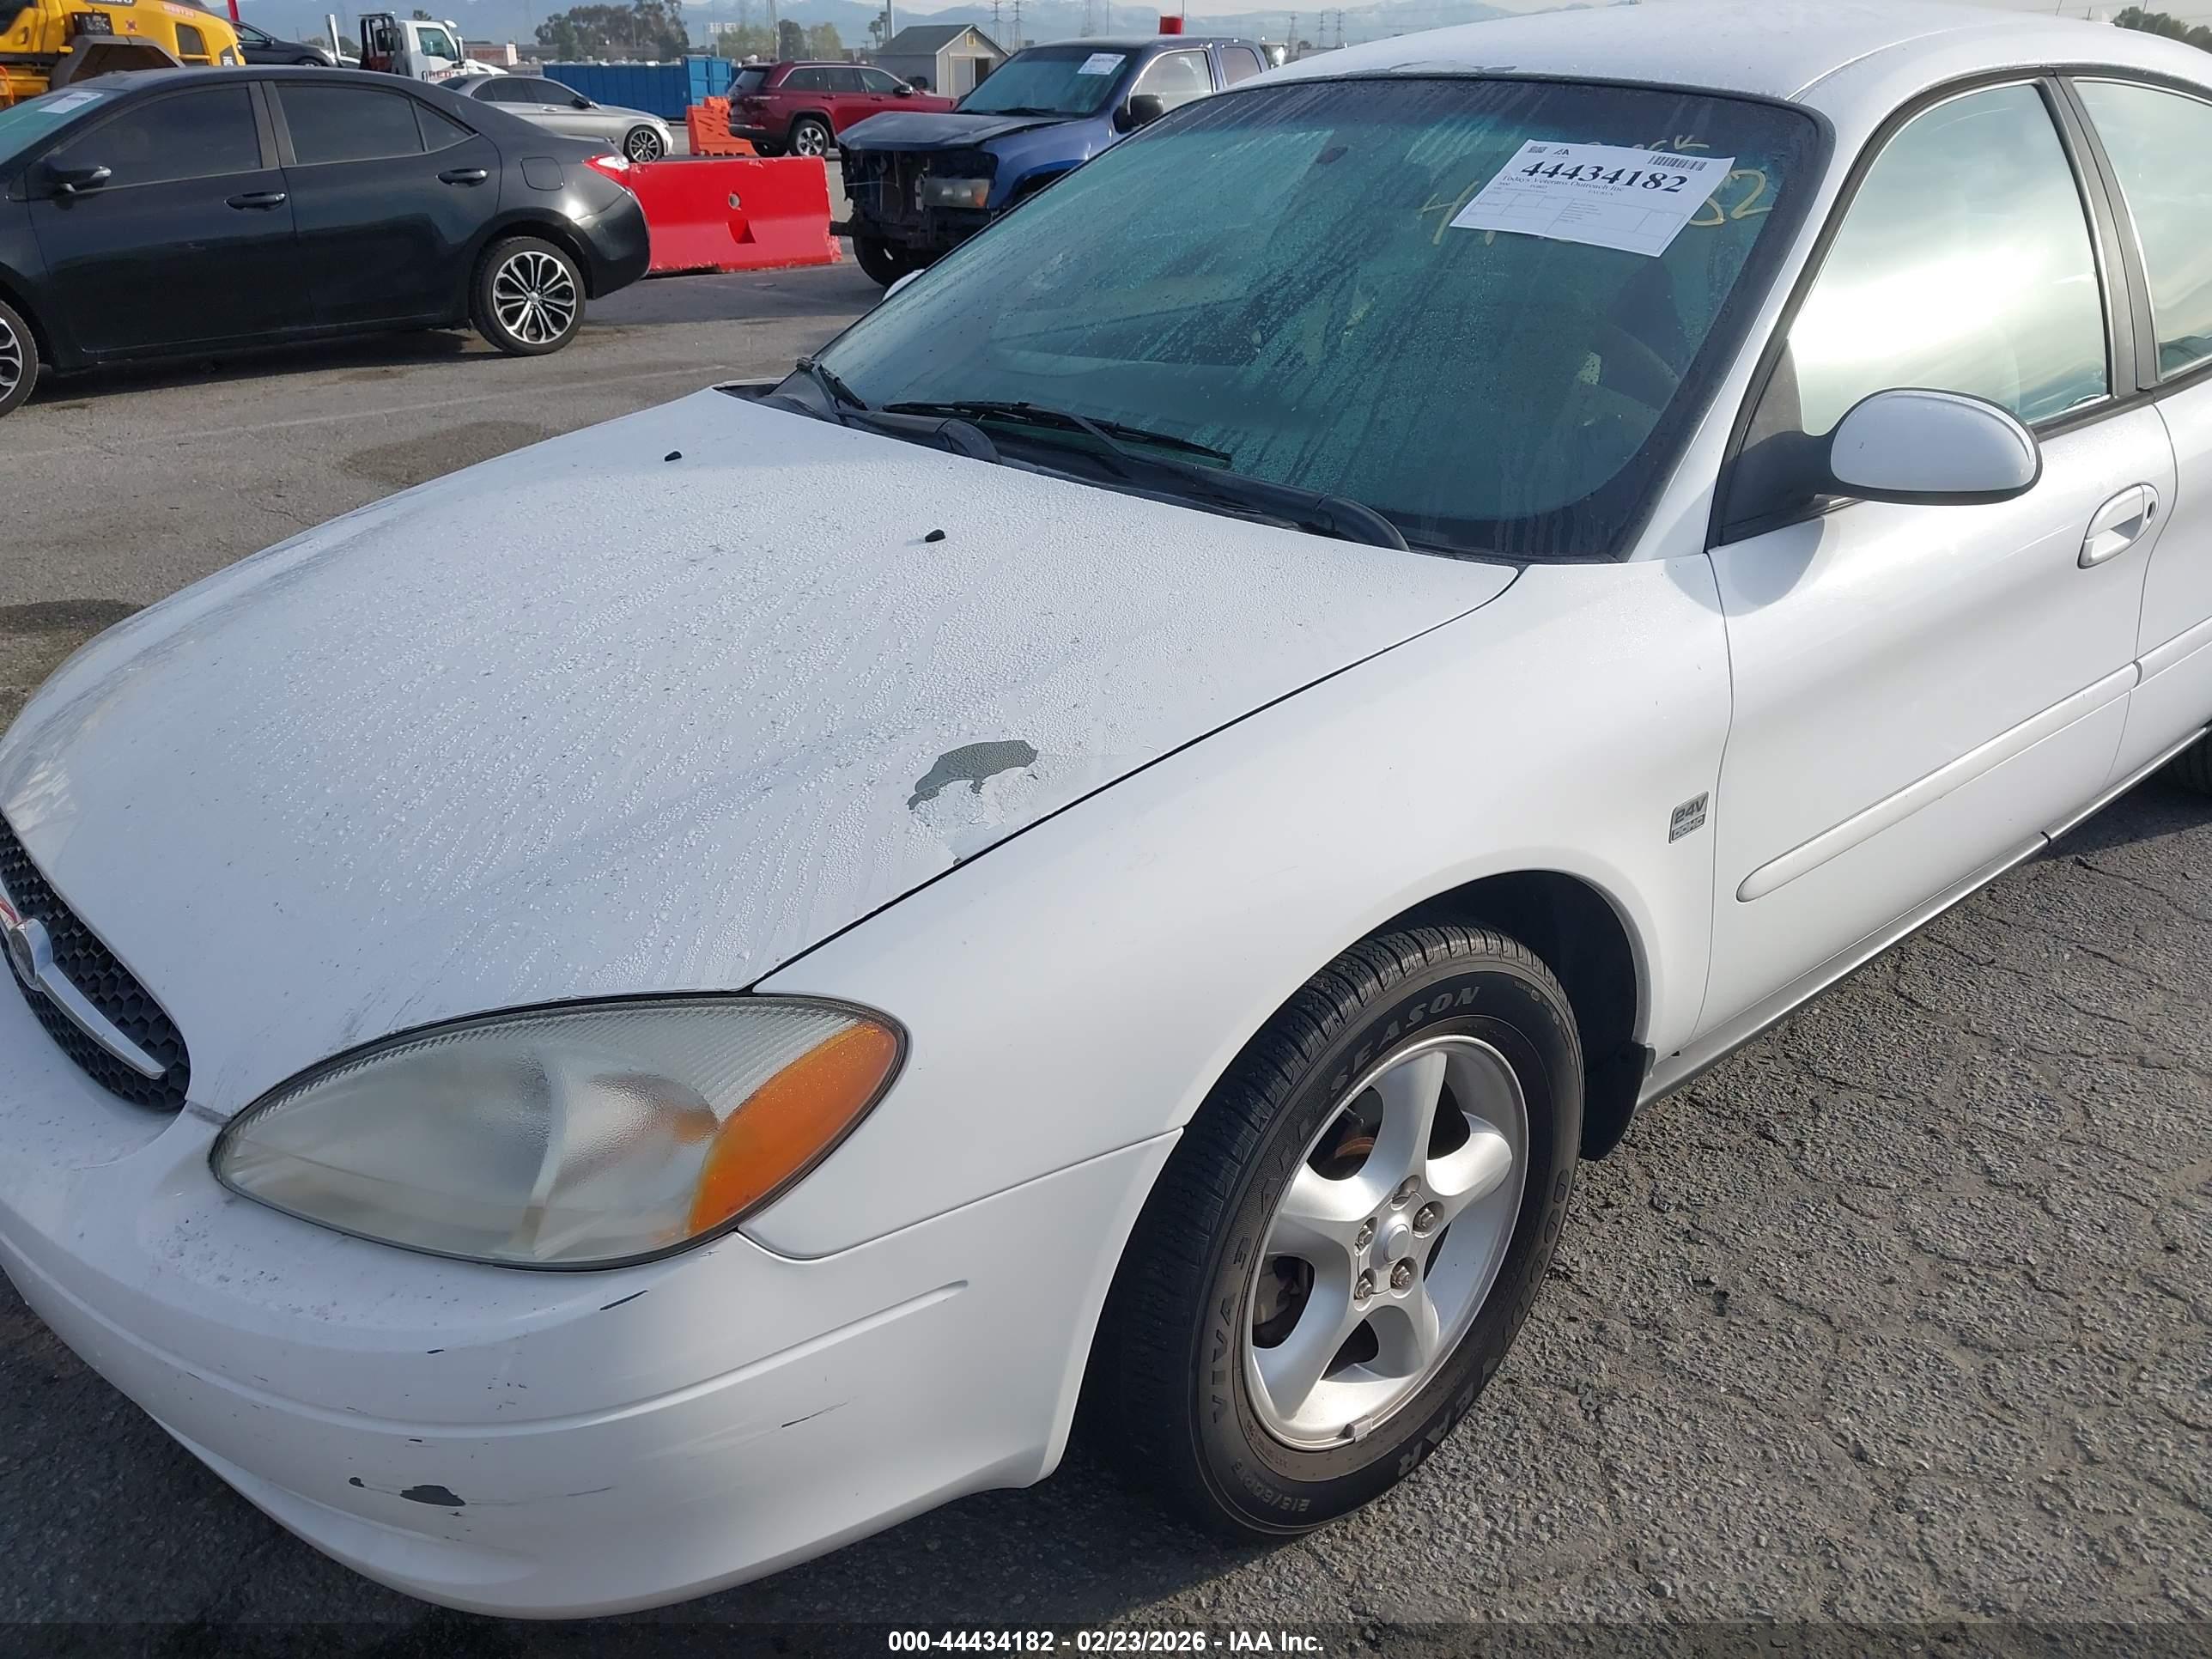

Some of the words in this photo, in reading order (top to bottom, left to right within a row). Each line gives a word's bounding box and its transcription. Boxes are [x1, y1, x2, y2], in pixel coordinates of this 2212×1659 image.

[1522, 161, 1687, 193] 44434182
[1571, 180, 1608, 190] Outreach
[1674, 796, 1706, 824] 24V
[1212, 1293, 1237, 1424] VIVA
